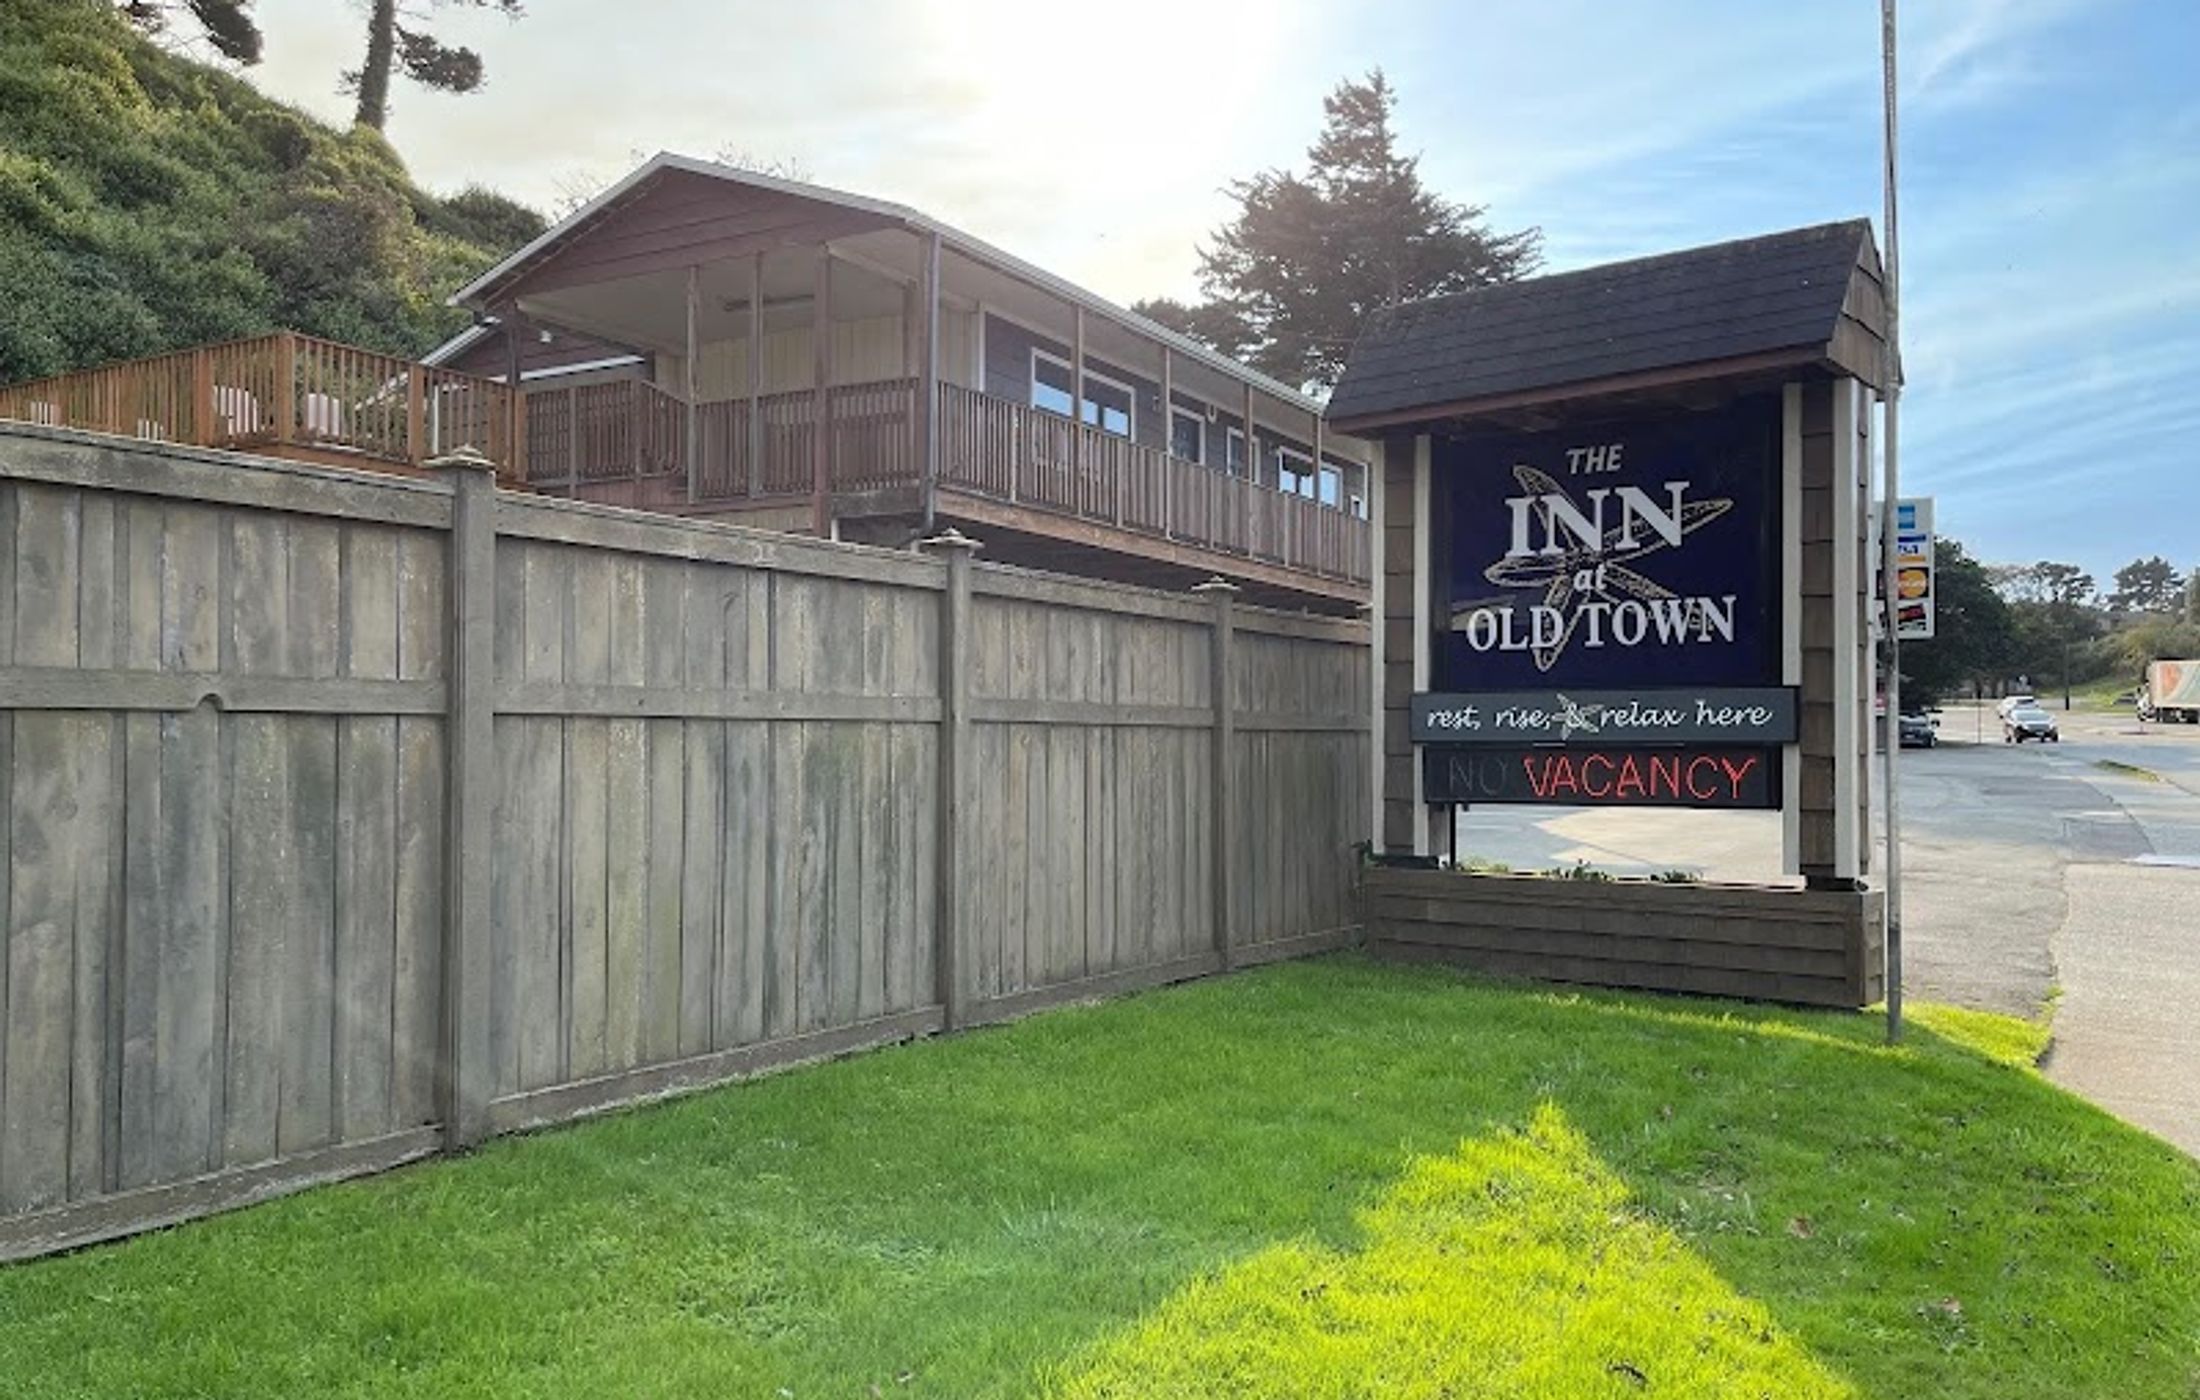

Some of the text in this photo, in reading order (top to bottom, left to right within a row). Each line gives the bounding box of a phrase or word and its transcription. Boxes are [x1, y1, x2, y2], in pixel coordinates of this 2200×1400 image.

[1565, 444, 1624, 475] THE
[1504, 481, 1691, 558] INN
[1573, 564, 1608, 591] at
[1466, 595, 1738, 652] OLD TOWN
[1427, 698, 1773, 731] rest, rise, & relax here
[1449, 754, 1757, 799] NO VACANCY
